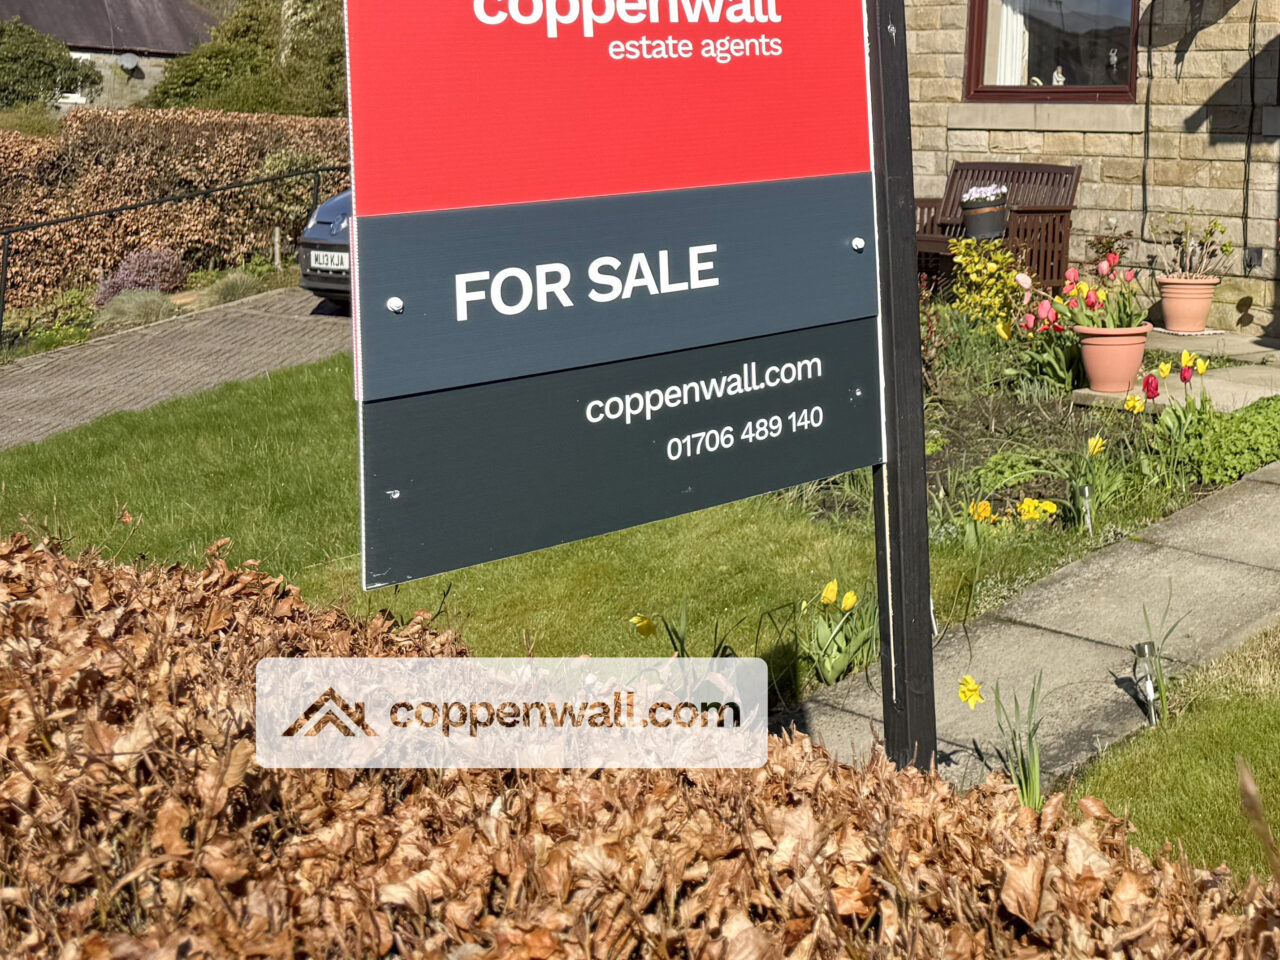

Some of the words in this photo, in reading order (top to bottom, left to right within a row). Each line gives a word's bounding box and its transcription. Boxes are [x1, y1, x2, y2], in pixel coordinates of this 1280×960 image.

[608, 35, 693, 60] estate
[700, 34, 783, 64] agents
[455, 262, 574, 321] FOR
[588, 244, 720, 303] SALE
[586, 356, 823, 426] coppenwall.com
[667, 425, 736, 461] 01706
[740, 416, 783, 443] 489
[787, 406, 824, 432] 140
